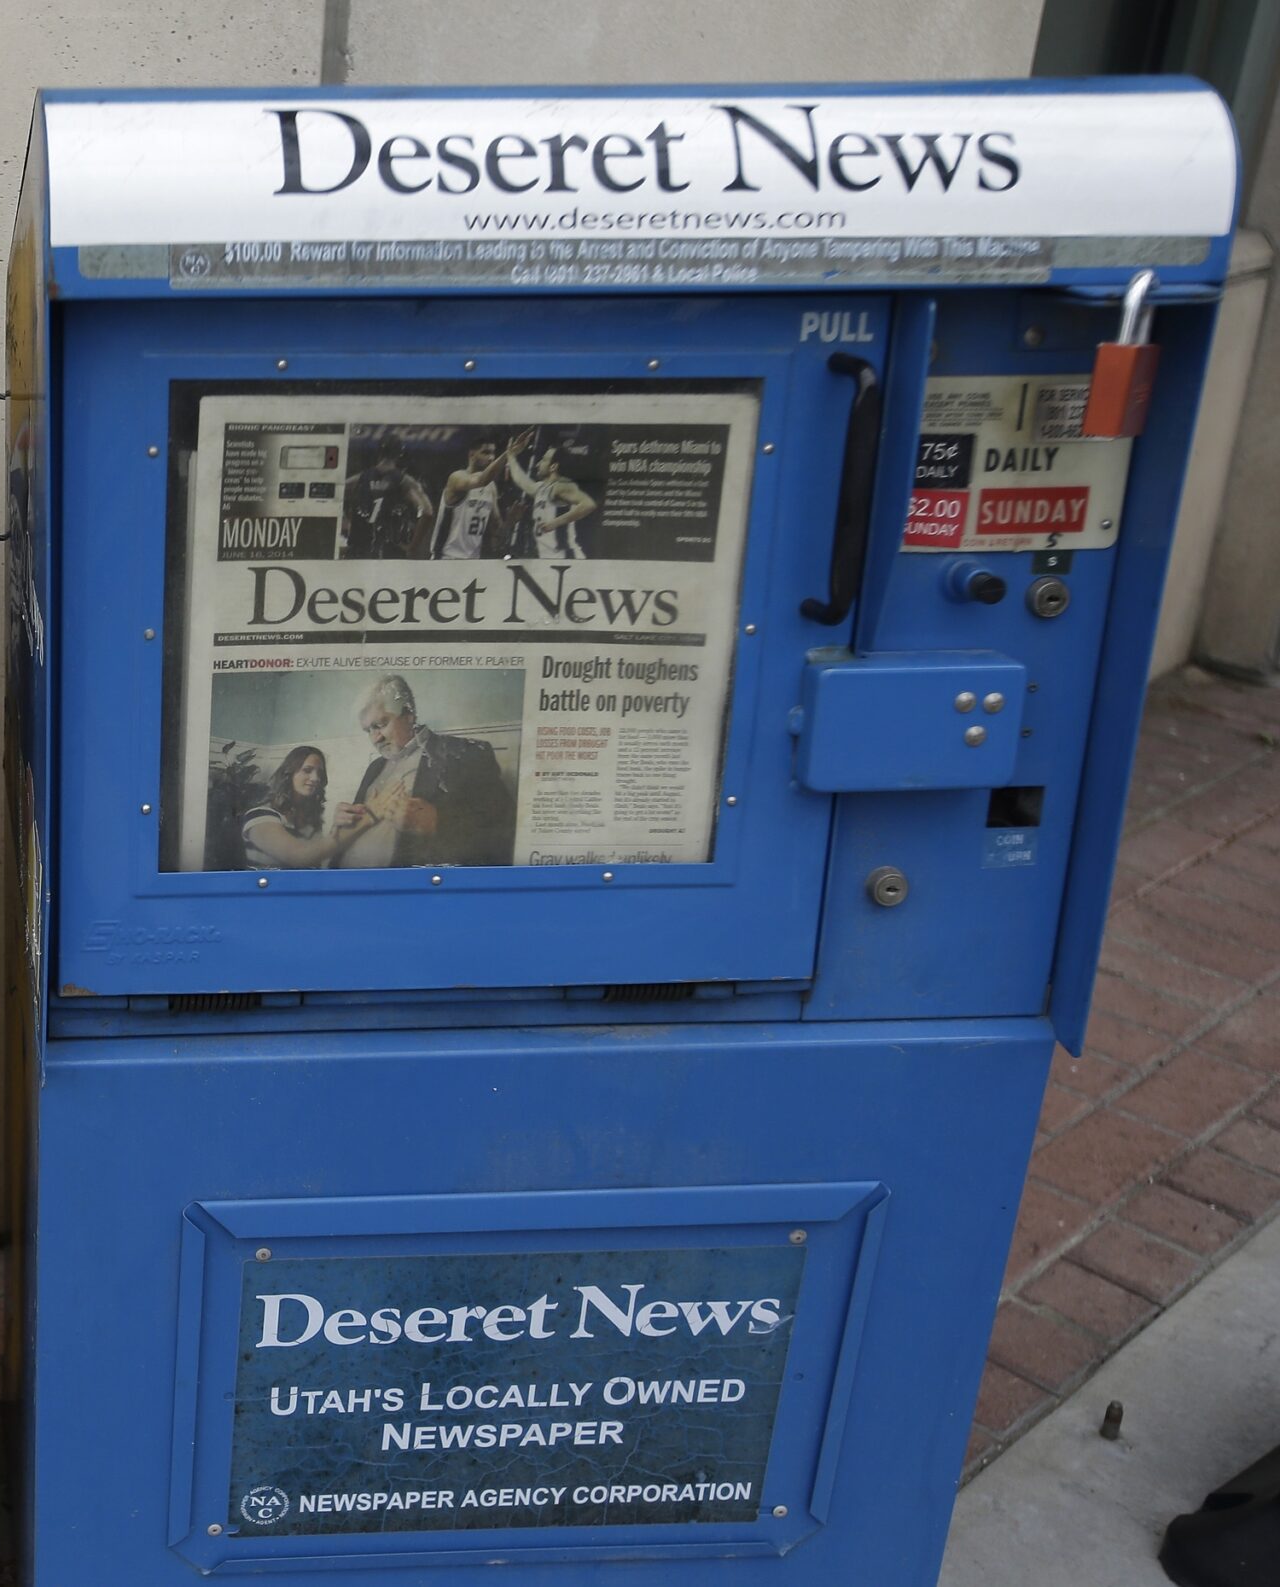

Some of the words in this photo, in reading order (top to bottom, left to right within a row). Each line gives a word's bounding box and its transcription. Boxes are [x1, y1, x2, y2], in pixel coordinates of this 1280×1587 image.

[265, 107, 693, 198] Deseret
[715, 105, 1022, 194] News
[463, 204, 847, 233] www.deseretnews.com
[224, 242, 281, 264] $100.00
[290, 241, 345, 262] Reward
[351, 241, 370, 261] for
[376, 240, 462, 261] Information
[465, 240, 524, 262] Leading
[530, 241, 545, 259] to
[627, 240, 655, 258] and
[658, 239, 739, 259] Conviction
[742, 238, 759, 258] of
[760, 238, 818, 263] Anyone
[822, 237, 901, 263] Tampering
[799, 311, 874, 343] PULL
[916, 465, 959, 478] DAILY
[984, 447, 1061, 473] DAILY
[981, 497, 1087, 525] SUNDAY
[223, 518, 303, 548] MONDAY
[1046, 532, 1062, 548] 5
[246, 565, 487, 627] Deseret
[503, 563, 679, 628] News
[218, 633, 304, 642] DESERETNEWS.COM
[296, 657, 331, 668] EX-UTE
[333, 657, 361, 668] ALIVE
[363, 656, 410, 668] BECAUSE
[412, 656, 427, 667] OF
[428, 656, 474, 667] FORMER
[542, 655, 612, 683] Drought
[617, 657, 699, 684] toughens
[539, 688, 590, 712] battle
[596, 695, 617, 712] on
[621, 691, 691, 719] poverty
[255, 1292, 559, 1349] Deseret
[570, 1283, 790, 1339] News
[270, 1386, 404, 1416] UTAH'S
[420, 1381, 594, 1412] LOCALLY
[603, 1375, 746, 1405] OWNED
[380, 1420, 625, 1451] NEWSPAPER
[299, 1488, 455, 1513] NEWSPAPER
[461, 1485, 566, 1508] AGENCY
[570, 1480, 752, 1506] CORPORATION
